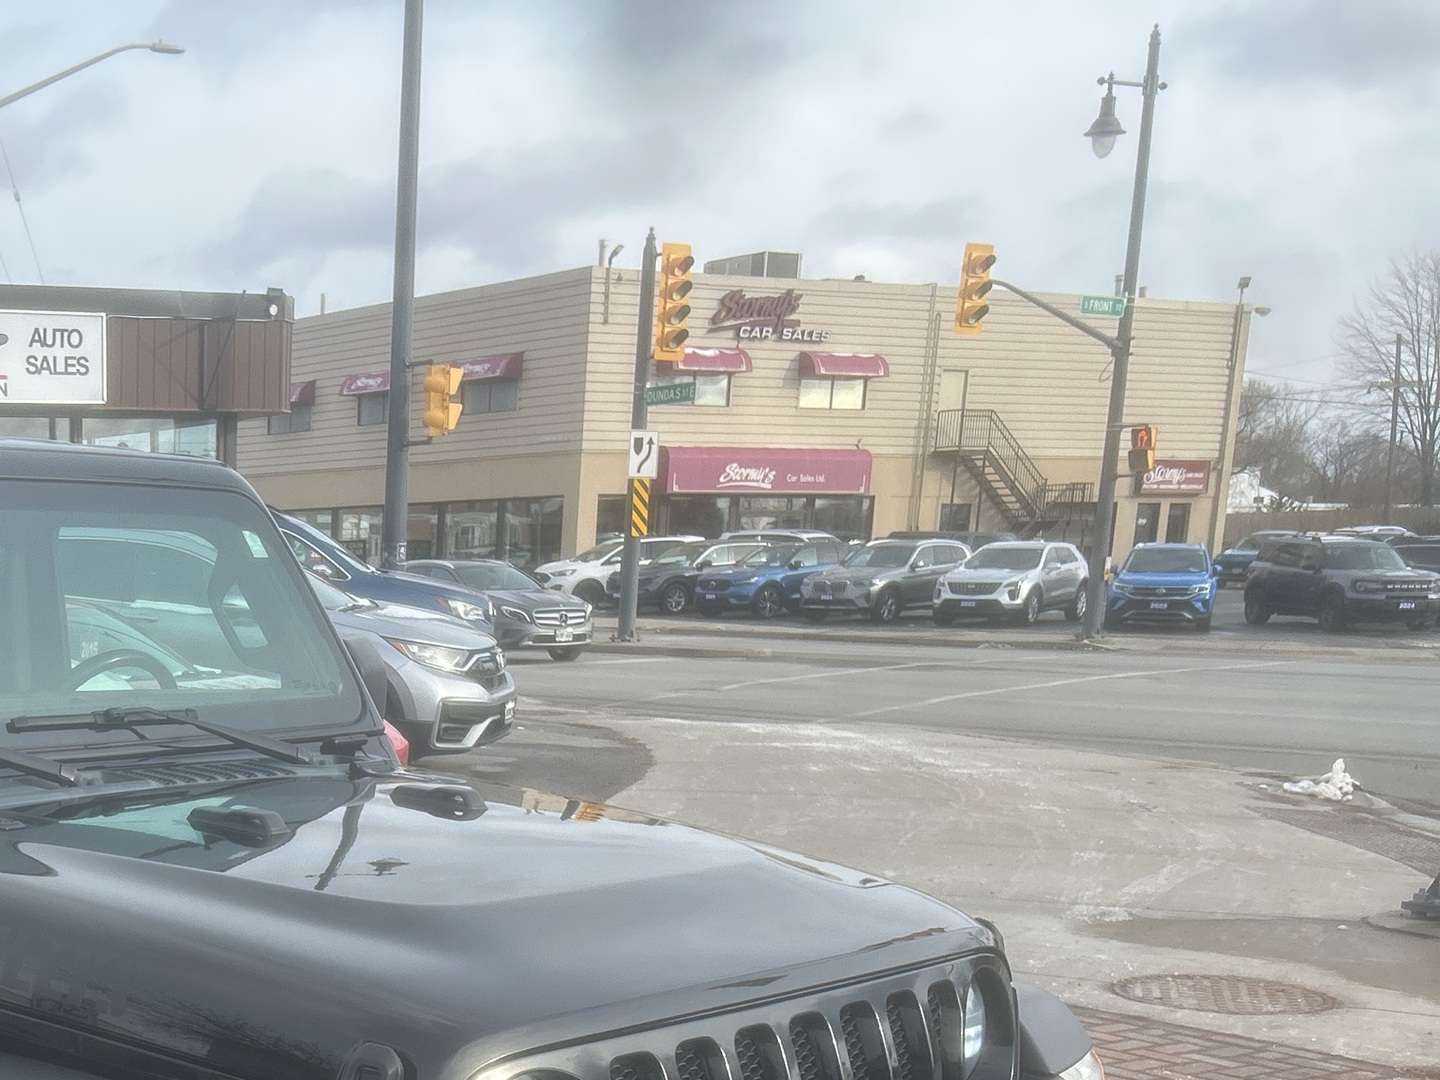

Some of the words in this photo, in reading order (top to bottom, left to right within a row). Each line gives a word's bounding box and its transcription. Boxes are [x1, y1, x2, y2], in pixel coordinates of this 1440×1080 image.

[1088, 299, 1114, 313] FRONT
[28, 328, 83, 349] AUTO
[739, 326, 773, 340] CAR
[782, 328, 832, 342] SALES
[24, 356, 90, 376] SALES
[647, 387, 681, 402] DUNDAS
[719, 463, 776, 484] Stormy's
[786, 474, 798, 483] Car
